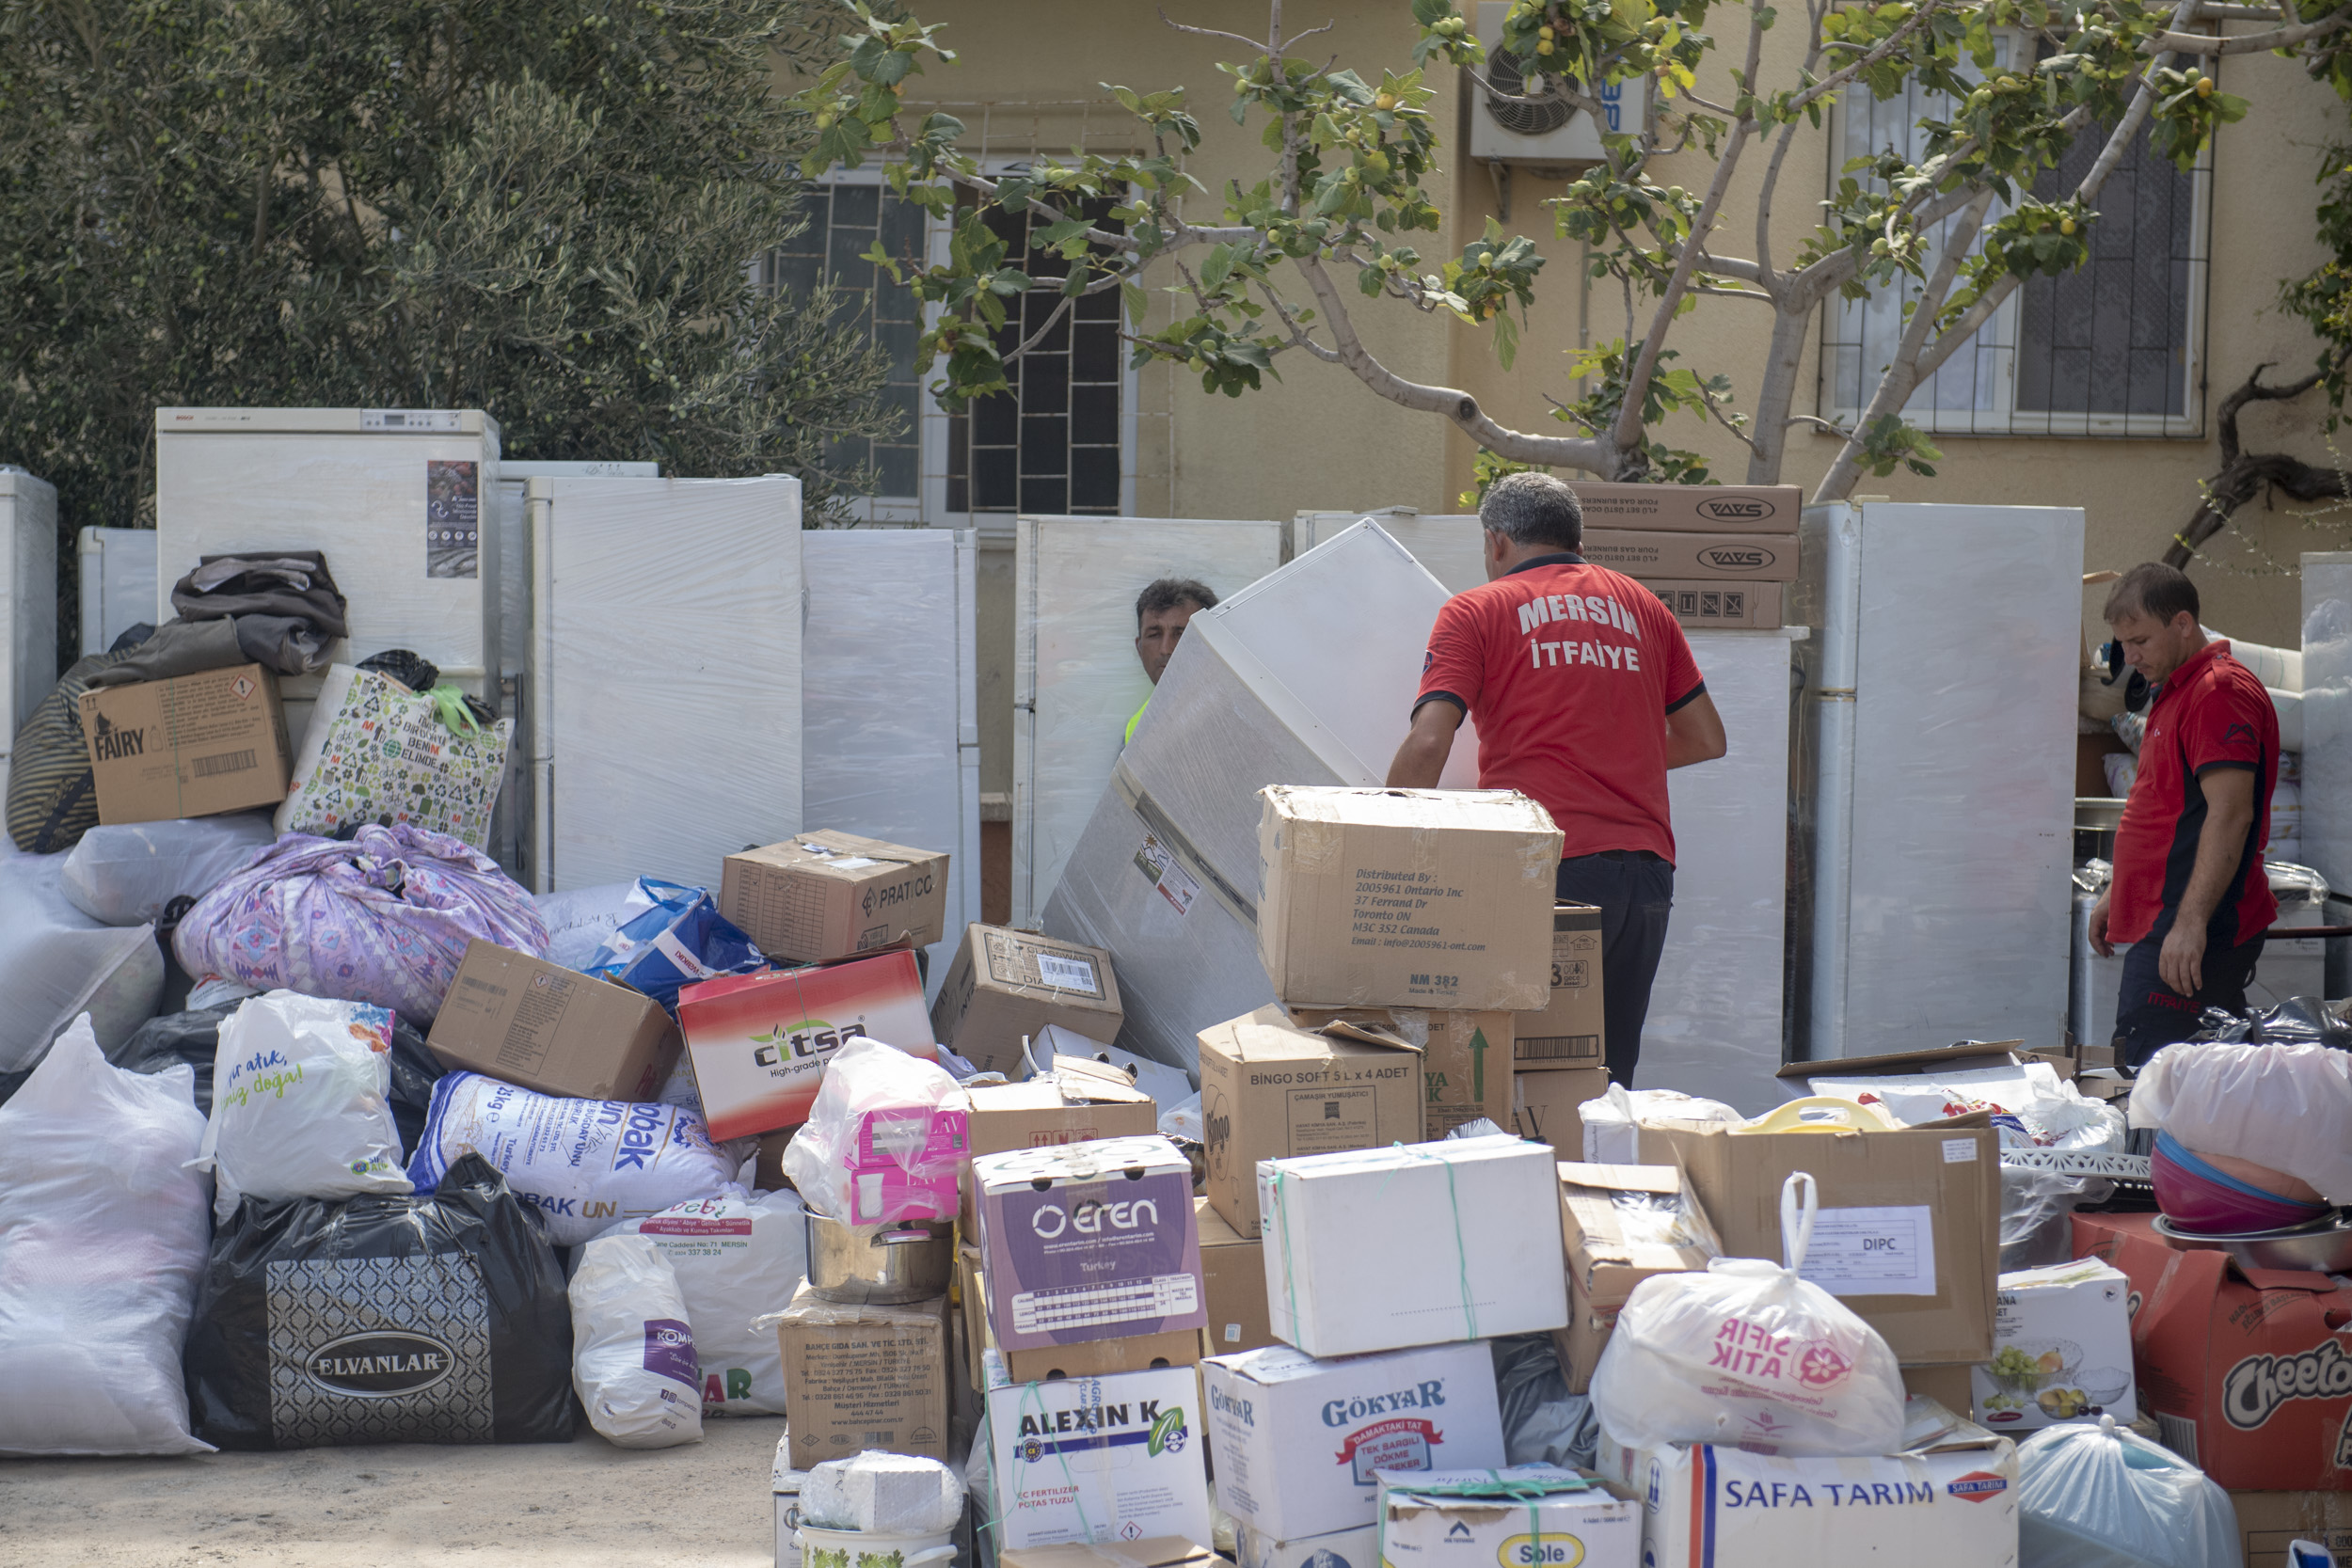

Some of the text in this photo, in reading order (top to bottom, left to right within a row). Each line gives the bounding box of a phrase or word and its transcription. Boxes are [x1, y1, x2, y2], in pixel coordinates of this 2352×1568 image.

[1518, 594, 1642, 641] MERSİN
[1531, 639, 1641, 672] İTFAİYE
[1356, 868, 1432, 883] Distributed By
[1356, 882, 1401, 895] 2005961
[1446, 887, 1464, 897] Inc
[1355, 895, 1428, 909] 37 Ferrand Dr
[1353, 909, 1411, 922] Toronto ON
[1352, 923, 1440, 936] M3C 3S2 Canada
[1351, 937, 1486, 952] Email info@2005961-ont.com
[1410, 974, 1459, 987] NM 382
[770, 1059, 821, 1078] High-grade
[1250, 1072, 1293, 1085] BİNGO
[1296, 1071, 1330, 1084] SOFT
[1333, 1071, 1341, 1082] 5
[1344, 1072, 1352, 1081] L
[1365, 1069, 1374, 1080] 4
[1375, 1067, 1409, 1080] ADET
[1424, 1072, 1449, 1087] YA
[580, 1201, 617, 1219] UN
[721, 1240, 748, 1248] MERSİN
[1863, 1238, 1897, 1251] DIPC
[1080, 1259, 1117, 1273] Turkey
[1996, 1295, 2017, 1306] ANA
[805, 1343, 831, 1352] BAHÇE
[832, 1341, 850, 1351] GIDA
[318, 1353, 440, 1376] ELVANLAR
[2224, 1339, 2352, 1429] Cheeto
[1322, 1379, 1446, 1428] GÖKYAR
[1019, 1403, 1129, 1438] ALEXIN
[1140, 1400, 1162, 1423] K
[1354, 1420, 1422, 1445] DAMAKTAKİ TAT
[1360, 1444, 1380, 1456] TEK
[1374, 1449, 1409, 1465] DÖKME
[1030, 1485, 1080, 1497] FERTILIZER
[1952, 1479, 2004, 1493] SAFA TARIM
[1048, 1497, 1074, 1505] TUZU
[1724, 1480, 1934, 1508] SAFA TARIM
[1519, 1544, 1565, 1563] Sole
